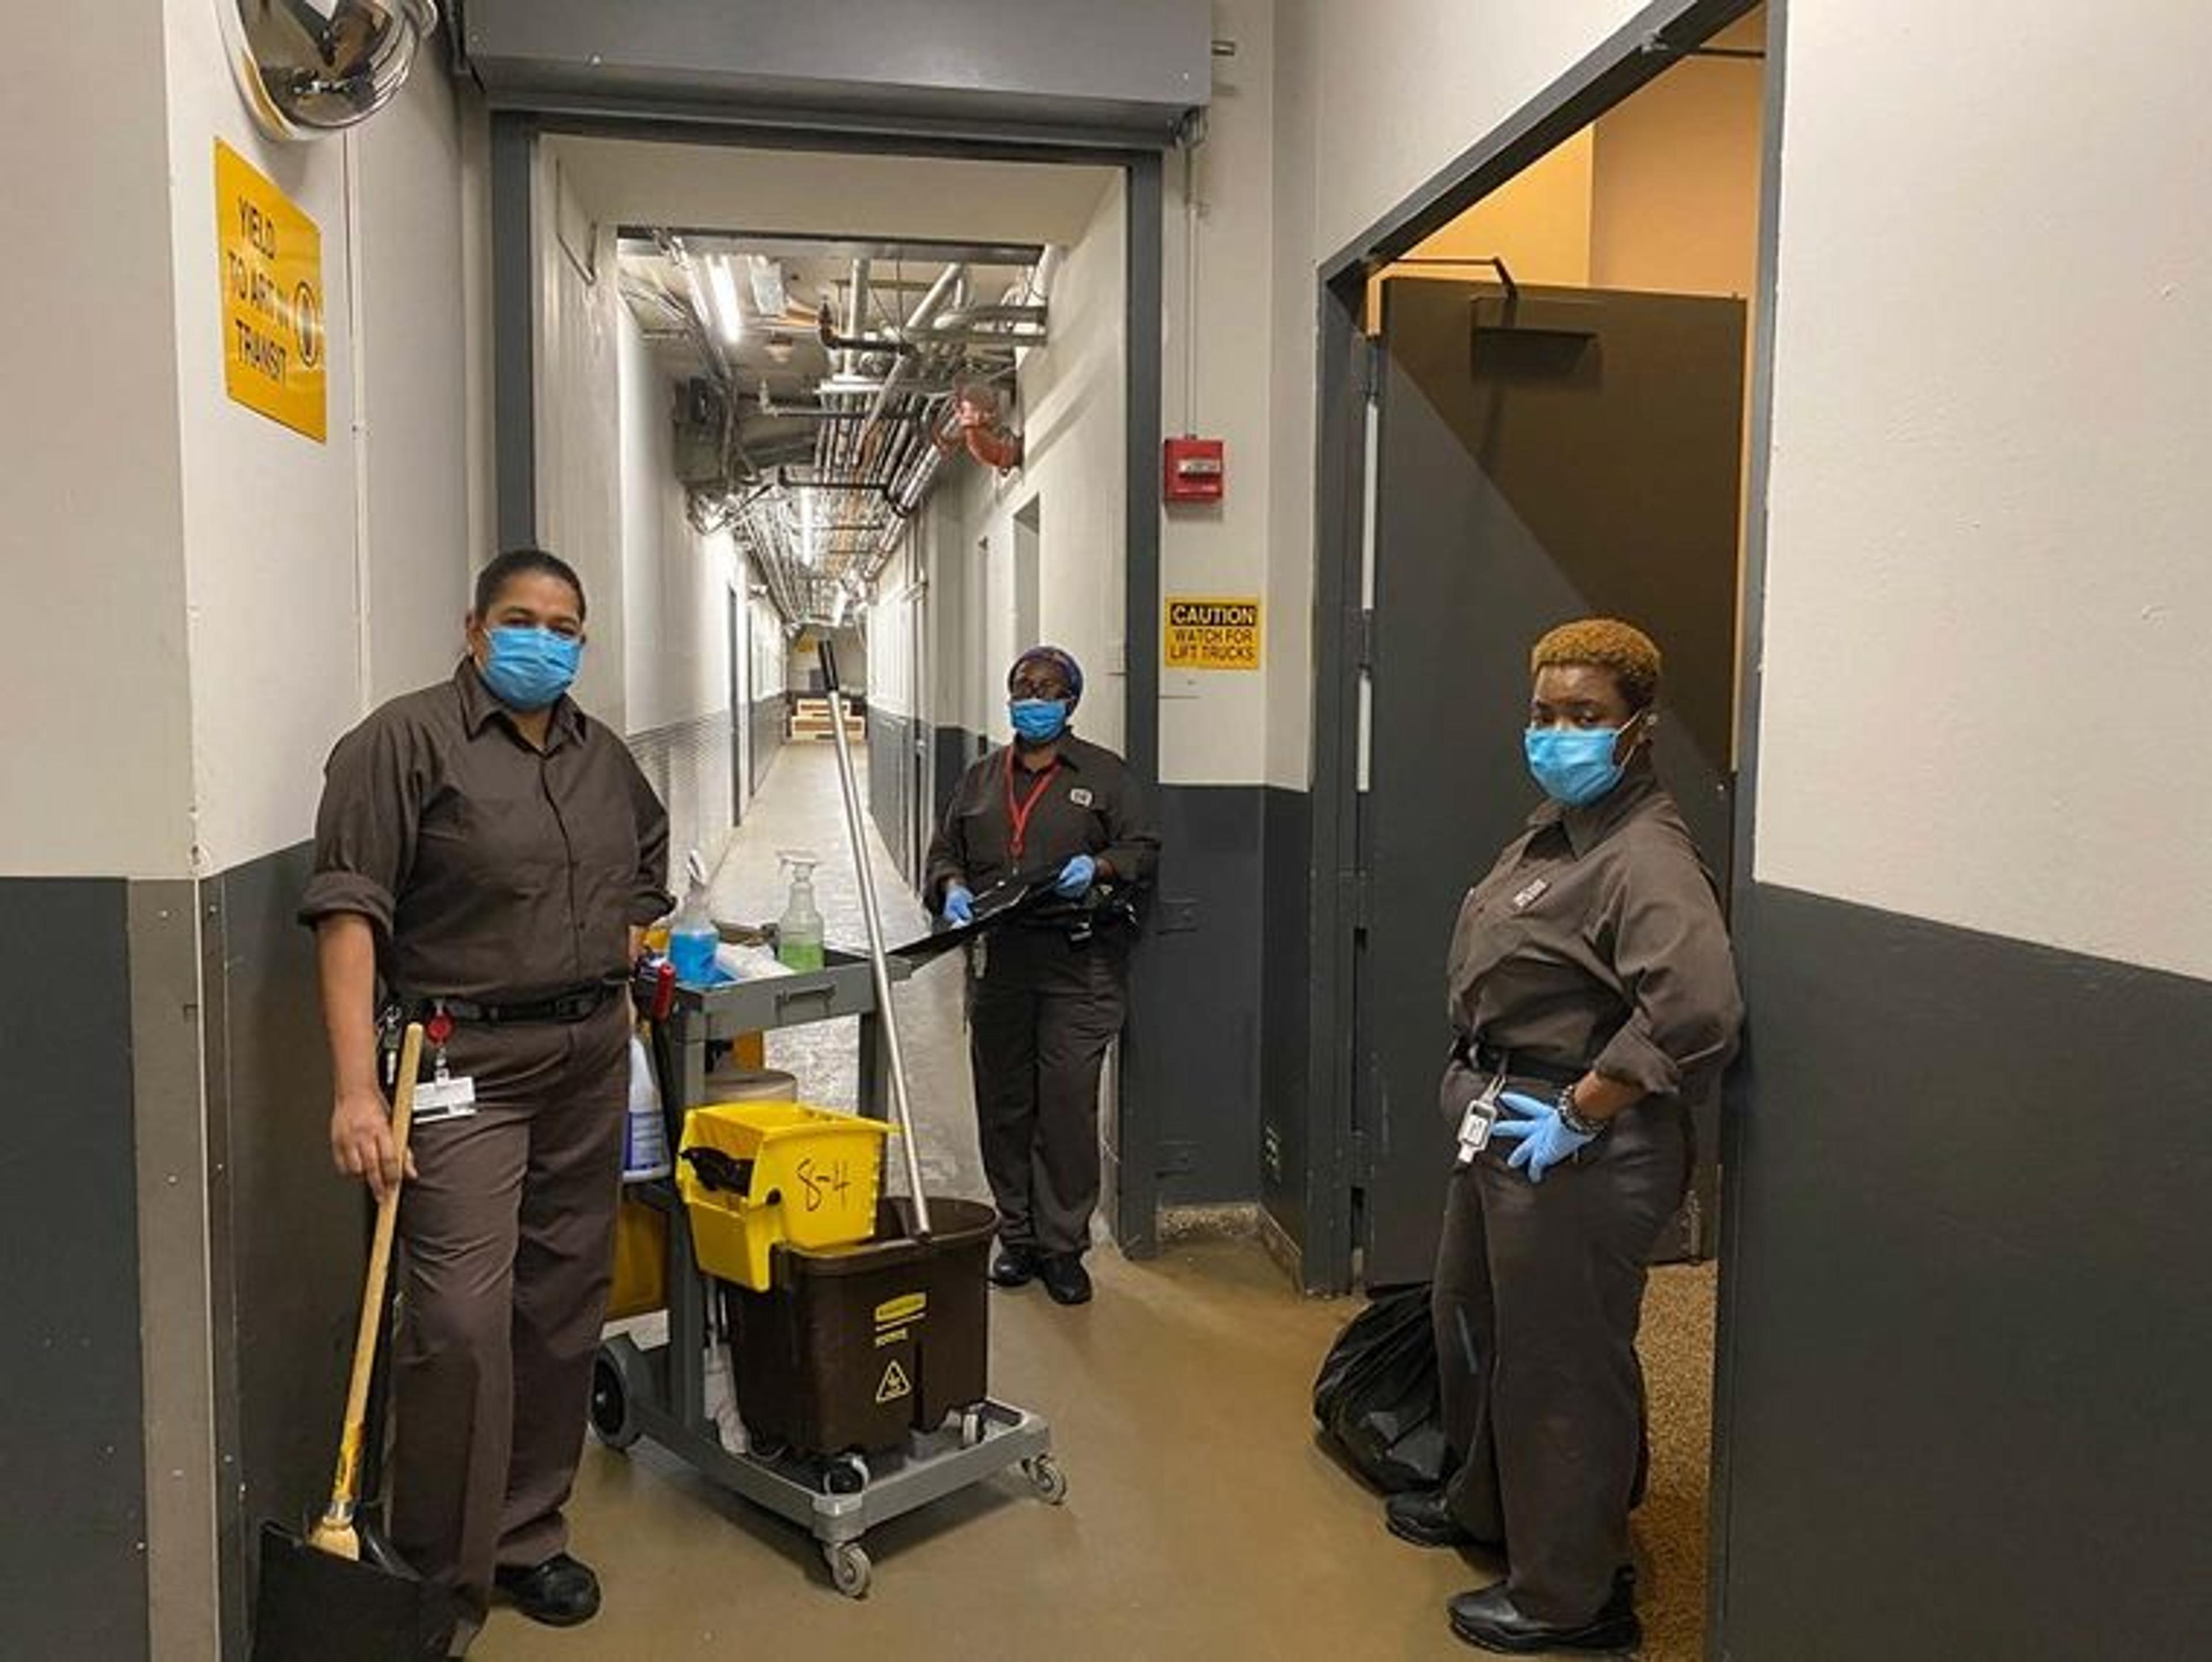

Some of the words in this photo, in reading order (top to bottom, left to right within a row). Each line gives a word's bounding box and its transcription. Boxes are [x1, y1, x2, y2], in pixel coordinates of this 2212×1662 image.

[238, 195, 275, 260] YIELD
[228, 250, 248, 301] TO
[236, 318, 286, 388] TRANSIT
[1172, 605, 1255, 624] CAUTION
[1170, 645, 1197, 659] LIFT
[1202, 645, 1255, 661] TRUCKS
[1173, 629, 1223, 644] WATCH
[1225, 629, 1252, 644] FOR
